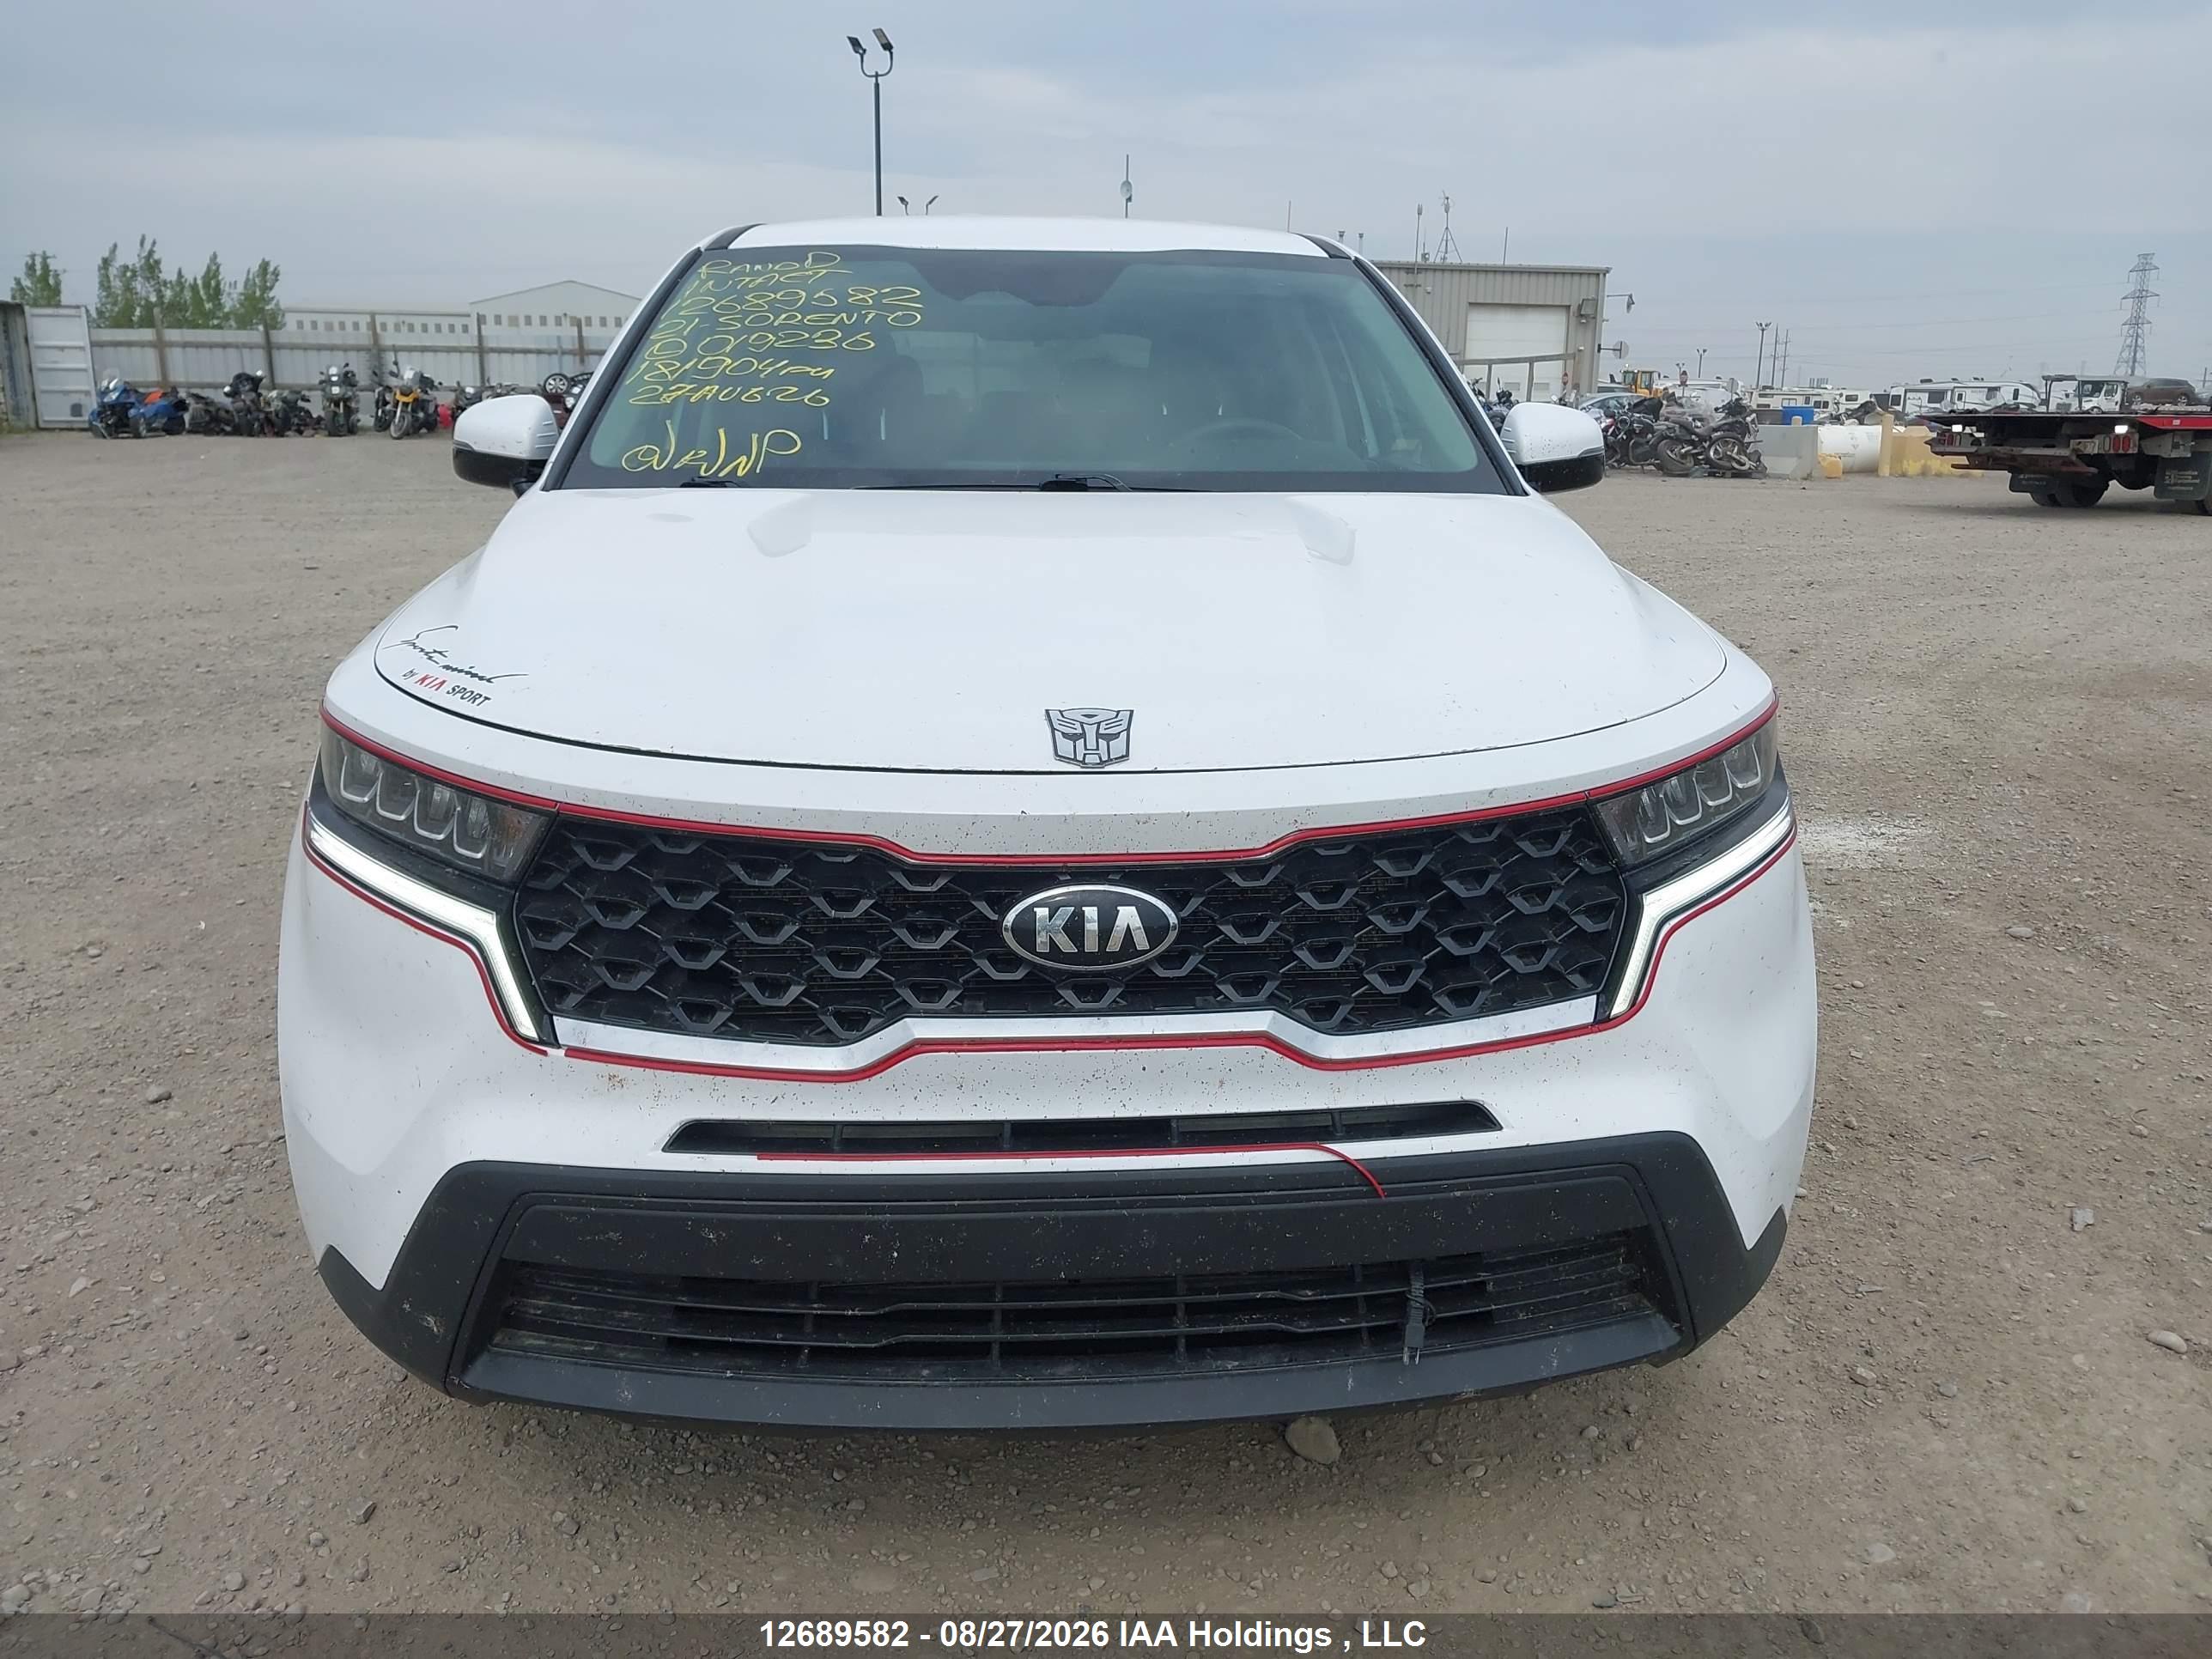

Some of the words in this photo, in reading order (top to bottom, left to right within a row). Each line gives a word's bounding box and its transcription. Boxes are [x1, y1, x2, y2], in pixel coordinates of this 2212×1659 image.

[662, 287, 924, 319] 12689582
[402, 668, 418, 680] by
[414, 673, 447, 691] KIA
[447, 684, 492, 707] SPORT
[1033, 906, 1151, 953] KIA
